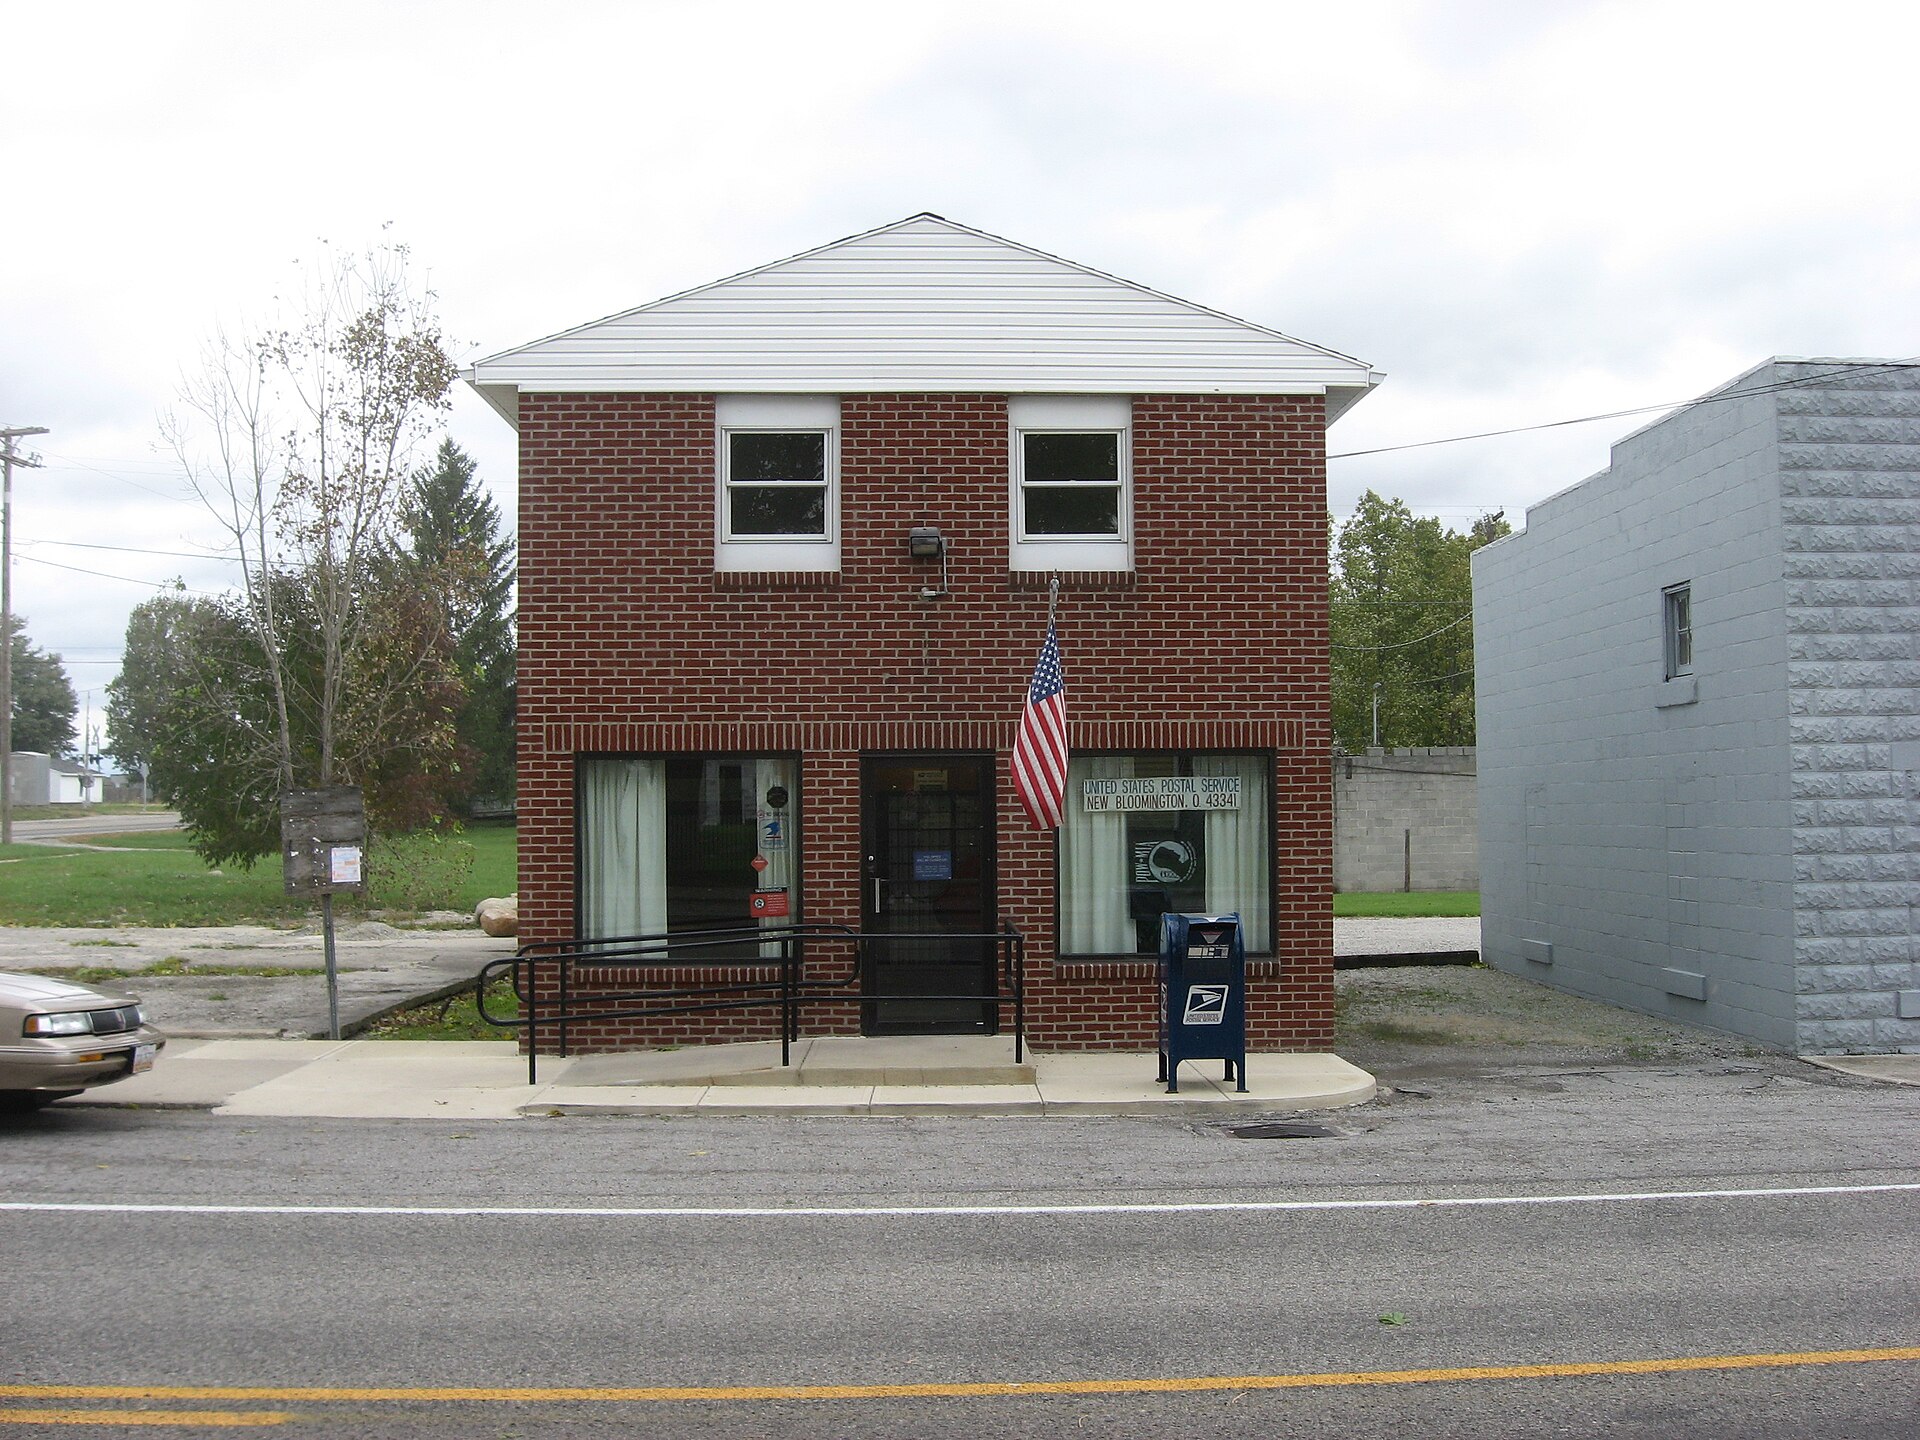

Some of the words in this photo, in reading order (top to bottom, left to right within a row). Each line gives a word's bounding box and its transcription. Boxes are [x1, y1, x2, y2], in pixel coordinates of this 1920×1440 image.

[1084, 780, 1117, 794] UNITED
[1122, 779, 1155, 794] STATES
[1161, 778, 1196, 793] POSTAL
[1201, 777, 1240, 793] SERVICE
[1087, 795, 1109, 810] NEW
[1205, 793, 1237, 808] 43341
